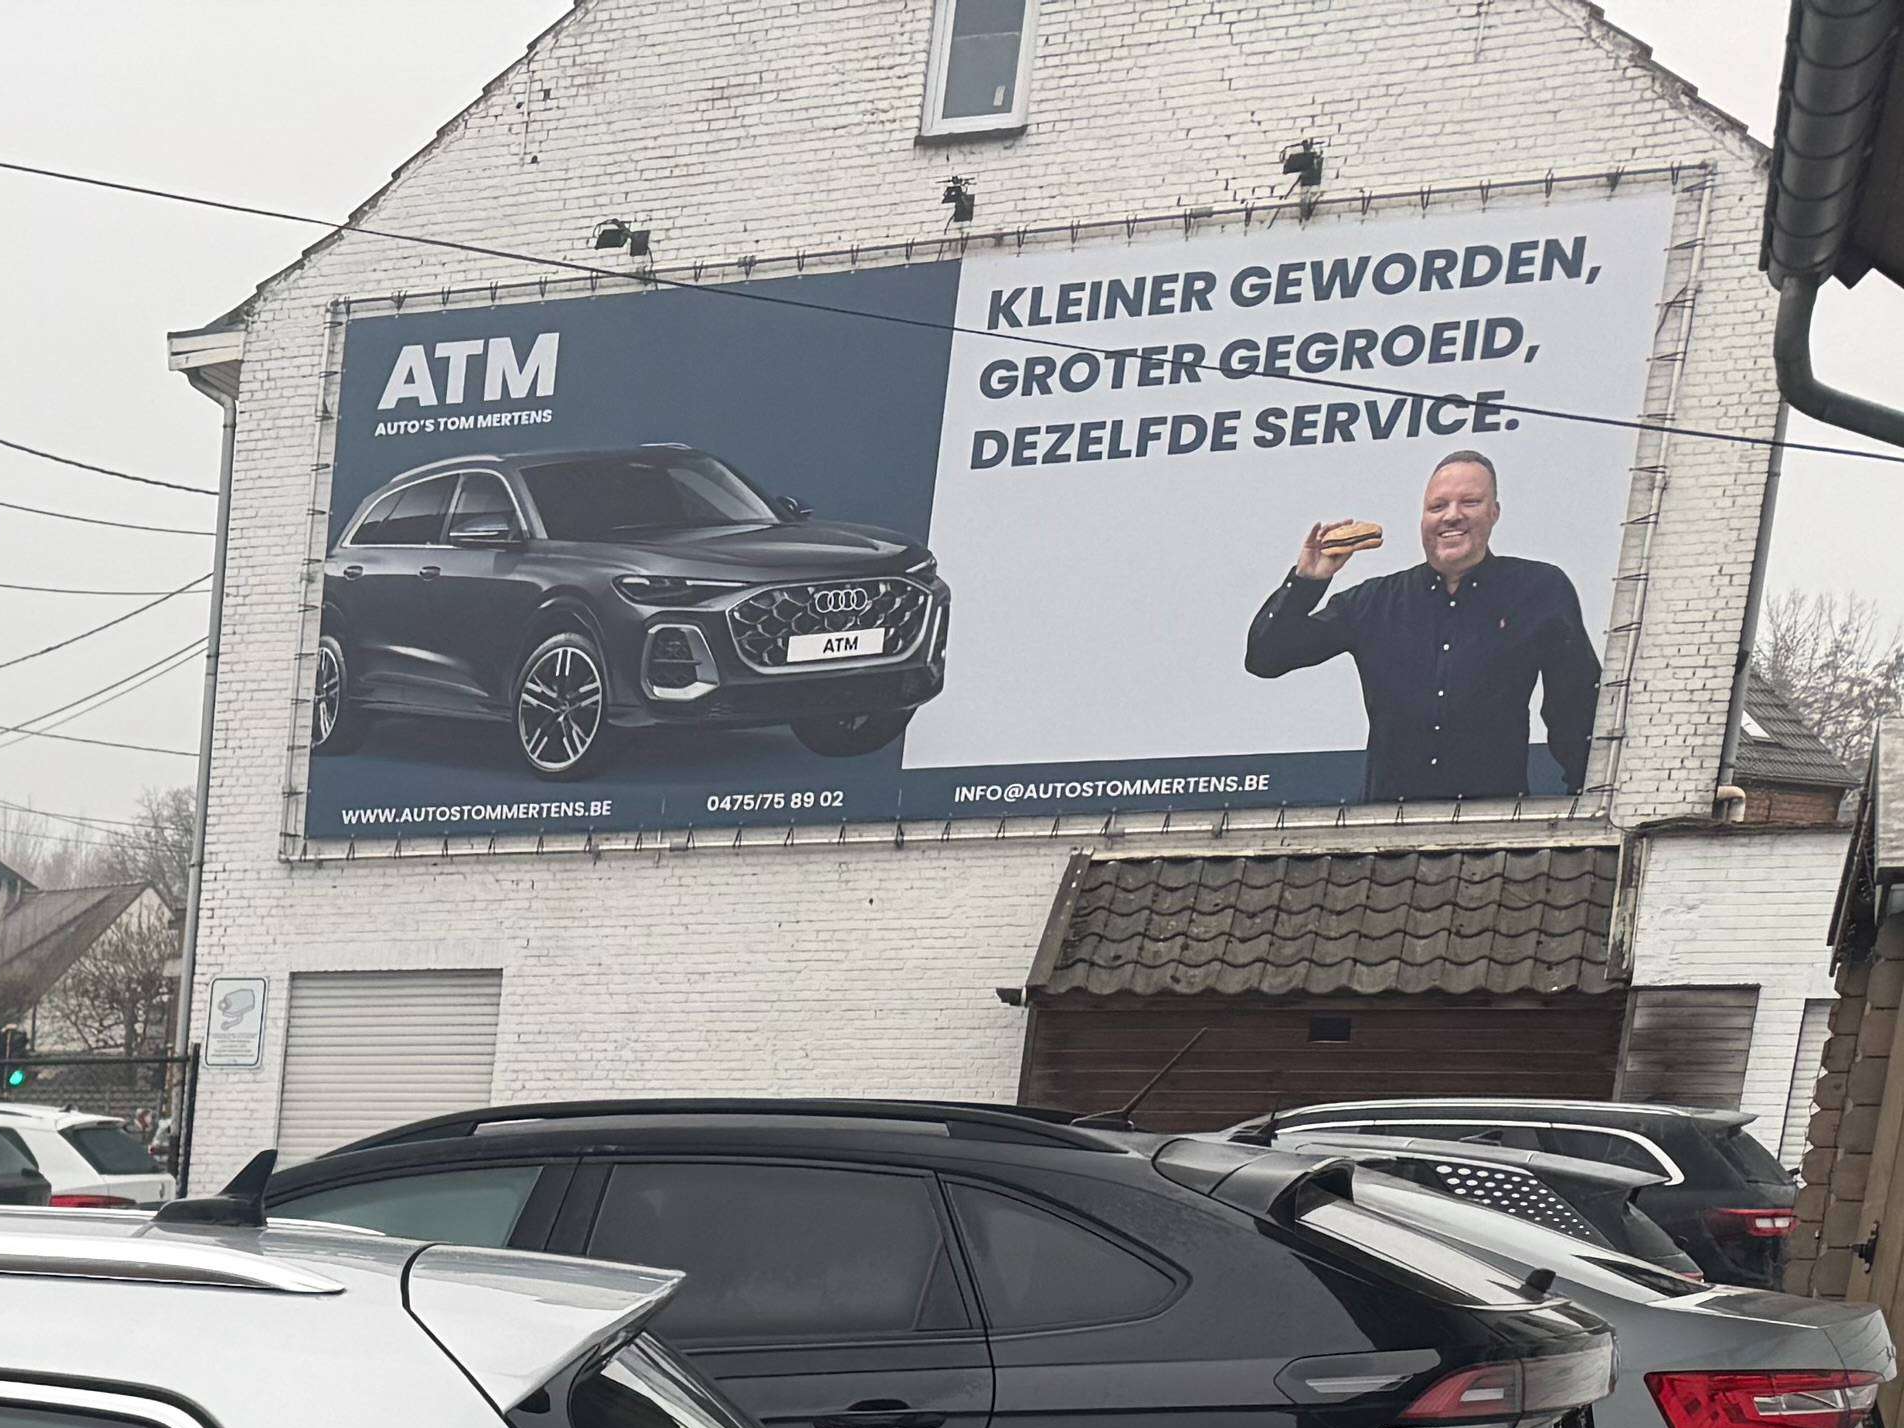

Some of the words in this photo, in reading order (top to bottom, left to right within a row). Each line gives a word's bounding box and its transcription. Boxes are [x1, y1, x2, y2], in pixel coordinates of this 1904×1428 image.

[987, 270, 1218, 331] KLEINER
[1230, 235, 1602, 308] GEWORDEN,
[376, 332, 560, 410] ATM
[979, 342, 1207, 399] GROTER
[1219, 316, 1541, 380] GEGROEID,
[374, 419, 435, 437] AUTO'S
[437, 415, 476, 432] TOM
[477, 409, 553, 429] MERTENS
[970, 409, 1242, 470] DEZELFDE
[1253, 389, 1520, 449] SERVICE.
[822, 635, 859, 654] ATM
[706, 793, 785, 812] 0475/75
[790, 791, 815, 809] 89
[819, 790, 844, 807] 02
[954, 774, 1270, 802] INFO@AUTOSTOMMERTENS.BE
[341, 799, 613, 825] WWW.AUTOSTOMMERTENS.BE
